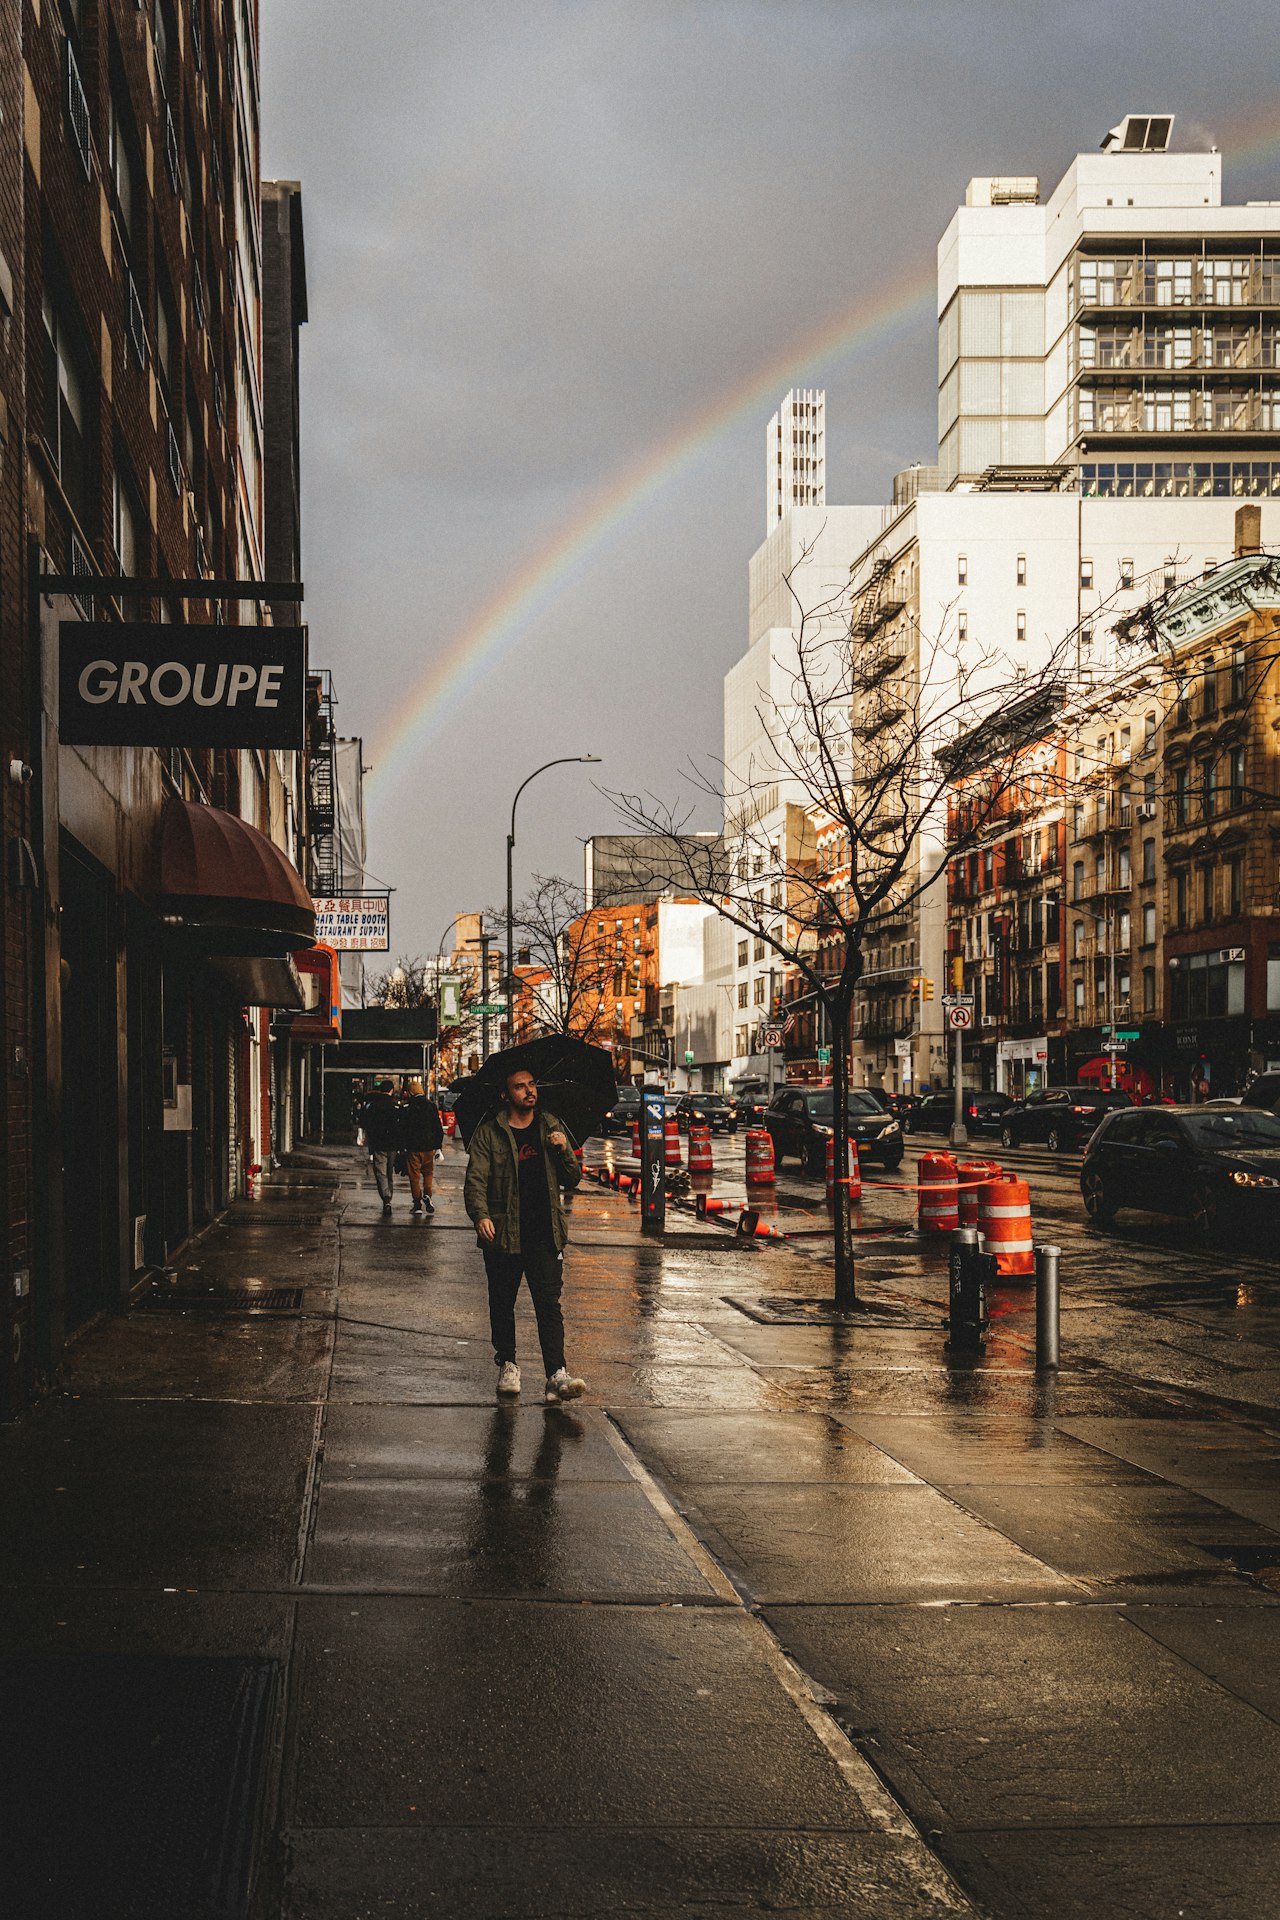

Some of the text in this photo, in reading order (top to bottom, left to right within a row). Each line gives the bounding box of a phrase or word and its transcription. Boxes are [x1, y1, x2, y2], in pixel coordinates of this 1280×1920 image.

[78, 660, 284, 708] GROUPE
[316, 913, 387, 924] HAIR TABLE BOOTH
[316, 926, 386, 936] ESTAURANT SUPPLY
